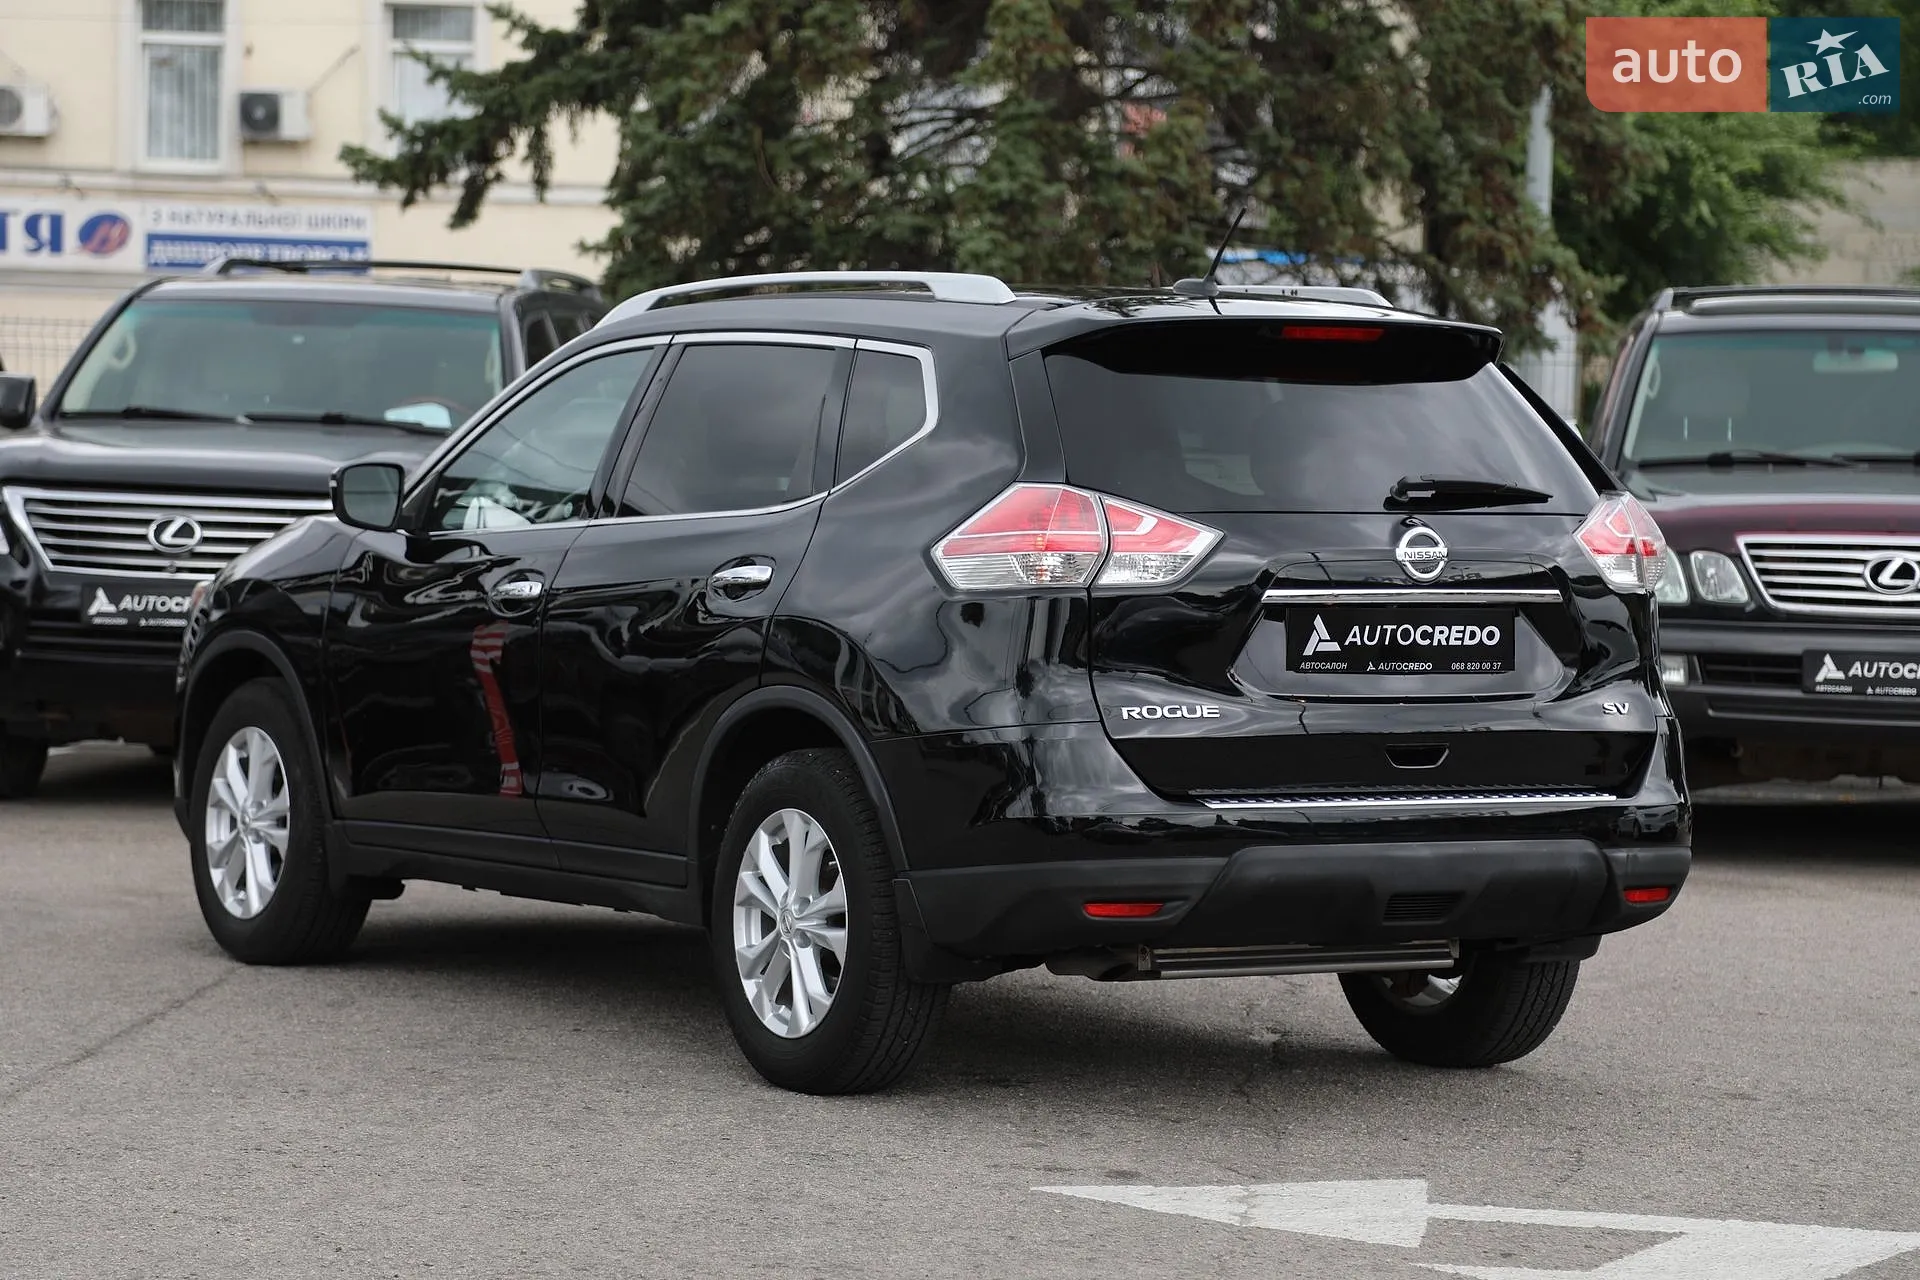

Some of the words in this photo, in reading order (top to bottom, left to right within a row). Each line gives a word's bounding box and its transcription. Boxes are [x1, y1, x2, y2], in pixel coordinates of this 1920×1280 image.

[1404, 550, 1446, 559] NISSAN
[1343, 623, 1501, 646] AUTOCREDO
[1299, 661, 1348, 670] АВТОСАЛОН
[1377, 662, 1433, 671] AUTOCREDO
[1451, 662, 1465, 670] 068
[1466, 662, 1480, 670] 820
[1481, 662, 1491, 670] 00
[1492, 662, 1502, 670] 37
[1847, 660, 1920, 679] AUTOC
[1121, 704, 1220, 720] ROGUE
[1602, 702, 1629, 715] SV
